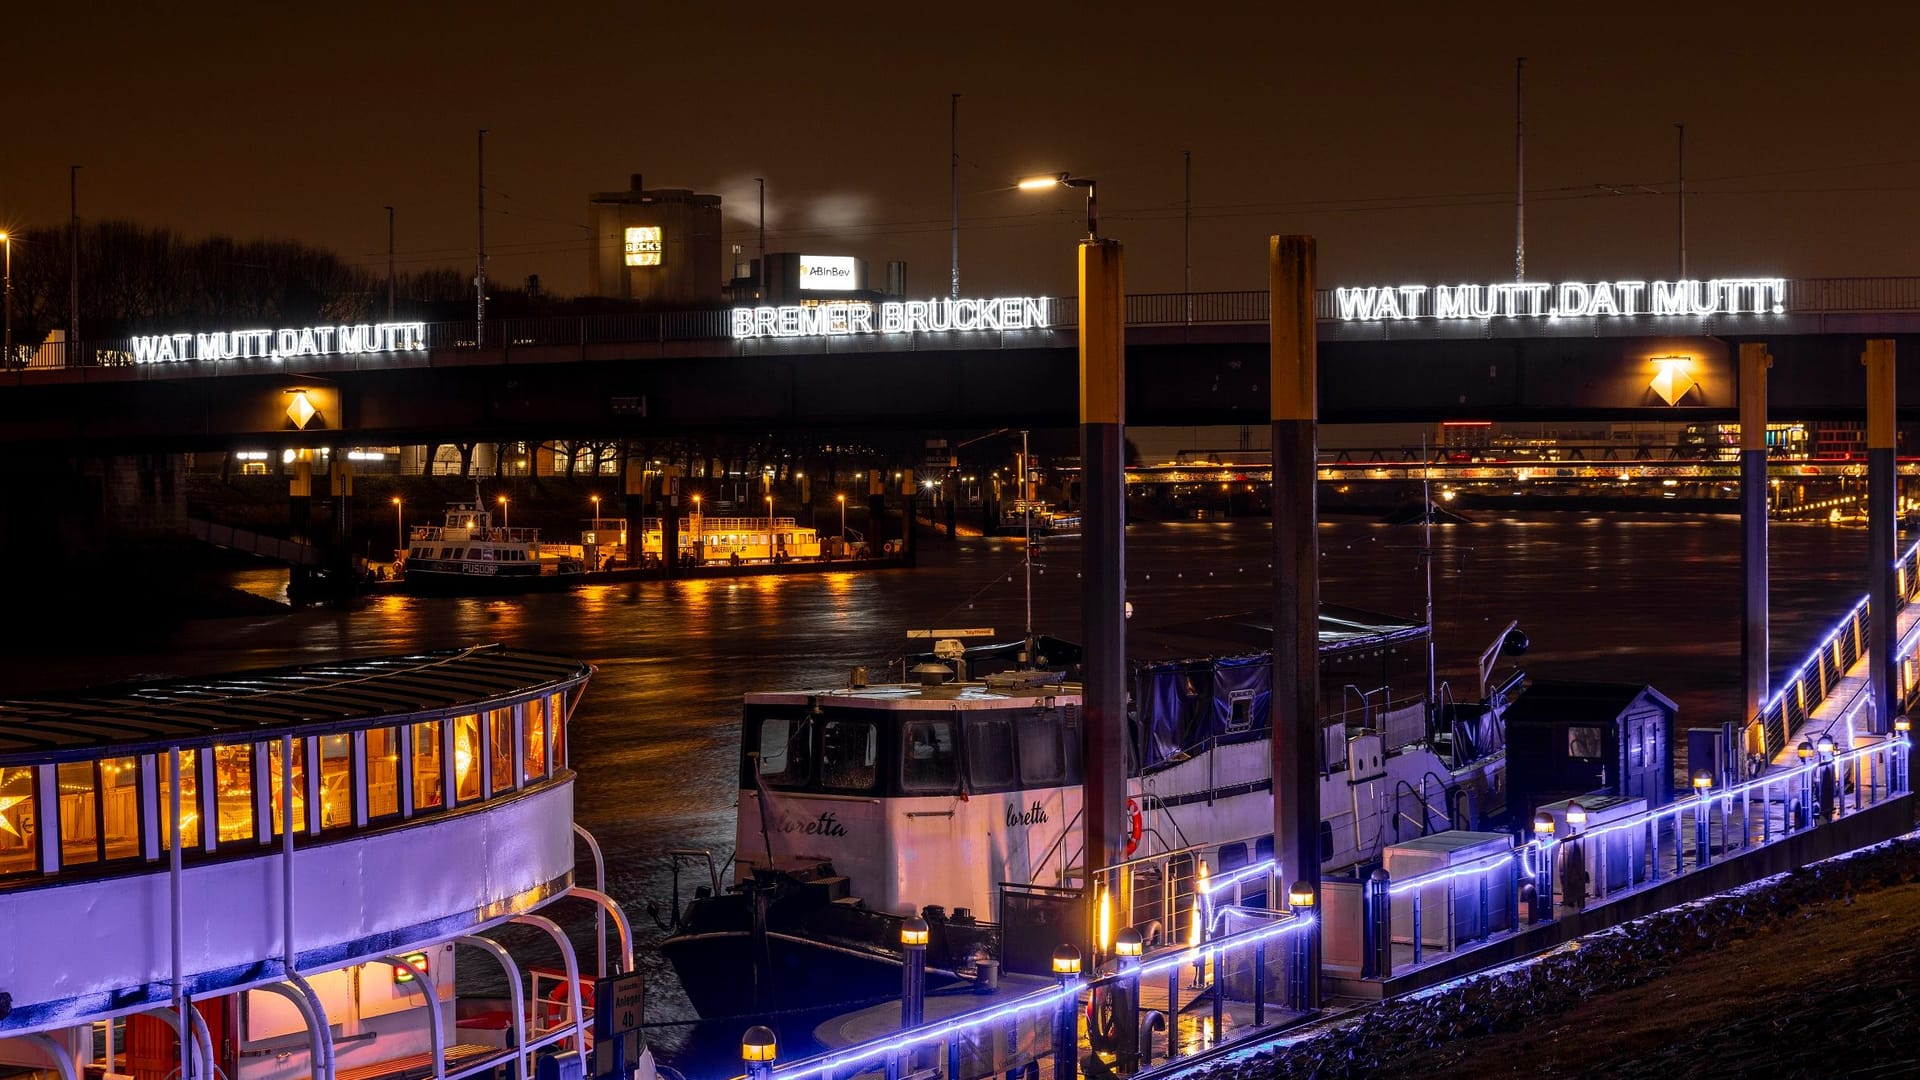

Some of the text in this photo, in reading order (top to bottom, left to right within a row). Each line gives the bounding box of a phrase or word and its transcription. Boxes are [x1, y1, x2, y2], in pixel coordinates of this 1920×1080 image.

[1336, 286, 1426, 319] WAT
[1652, 278, 1786, 314] MUTT!
[732, 306, 872, 338] BREMER
[131, 334, 191, 363] WAT
[339, 322, 425, 353] MUTT!
[623, 1010, 634, 1027] 4b
